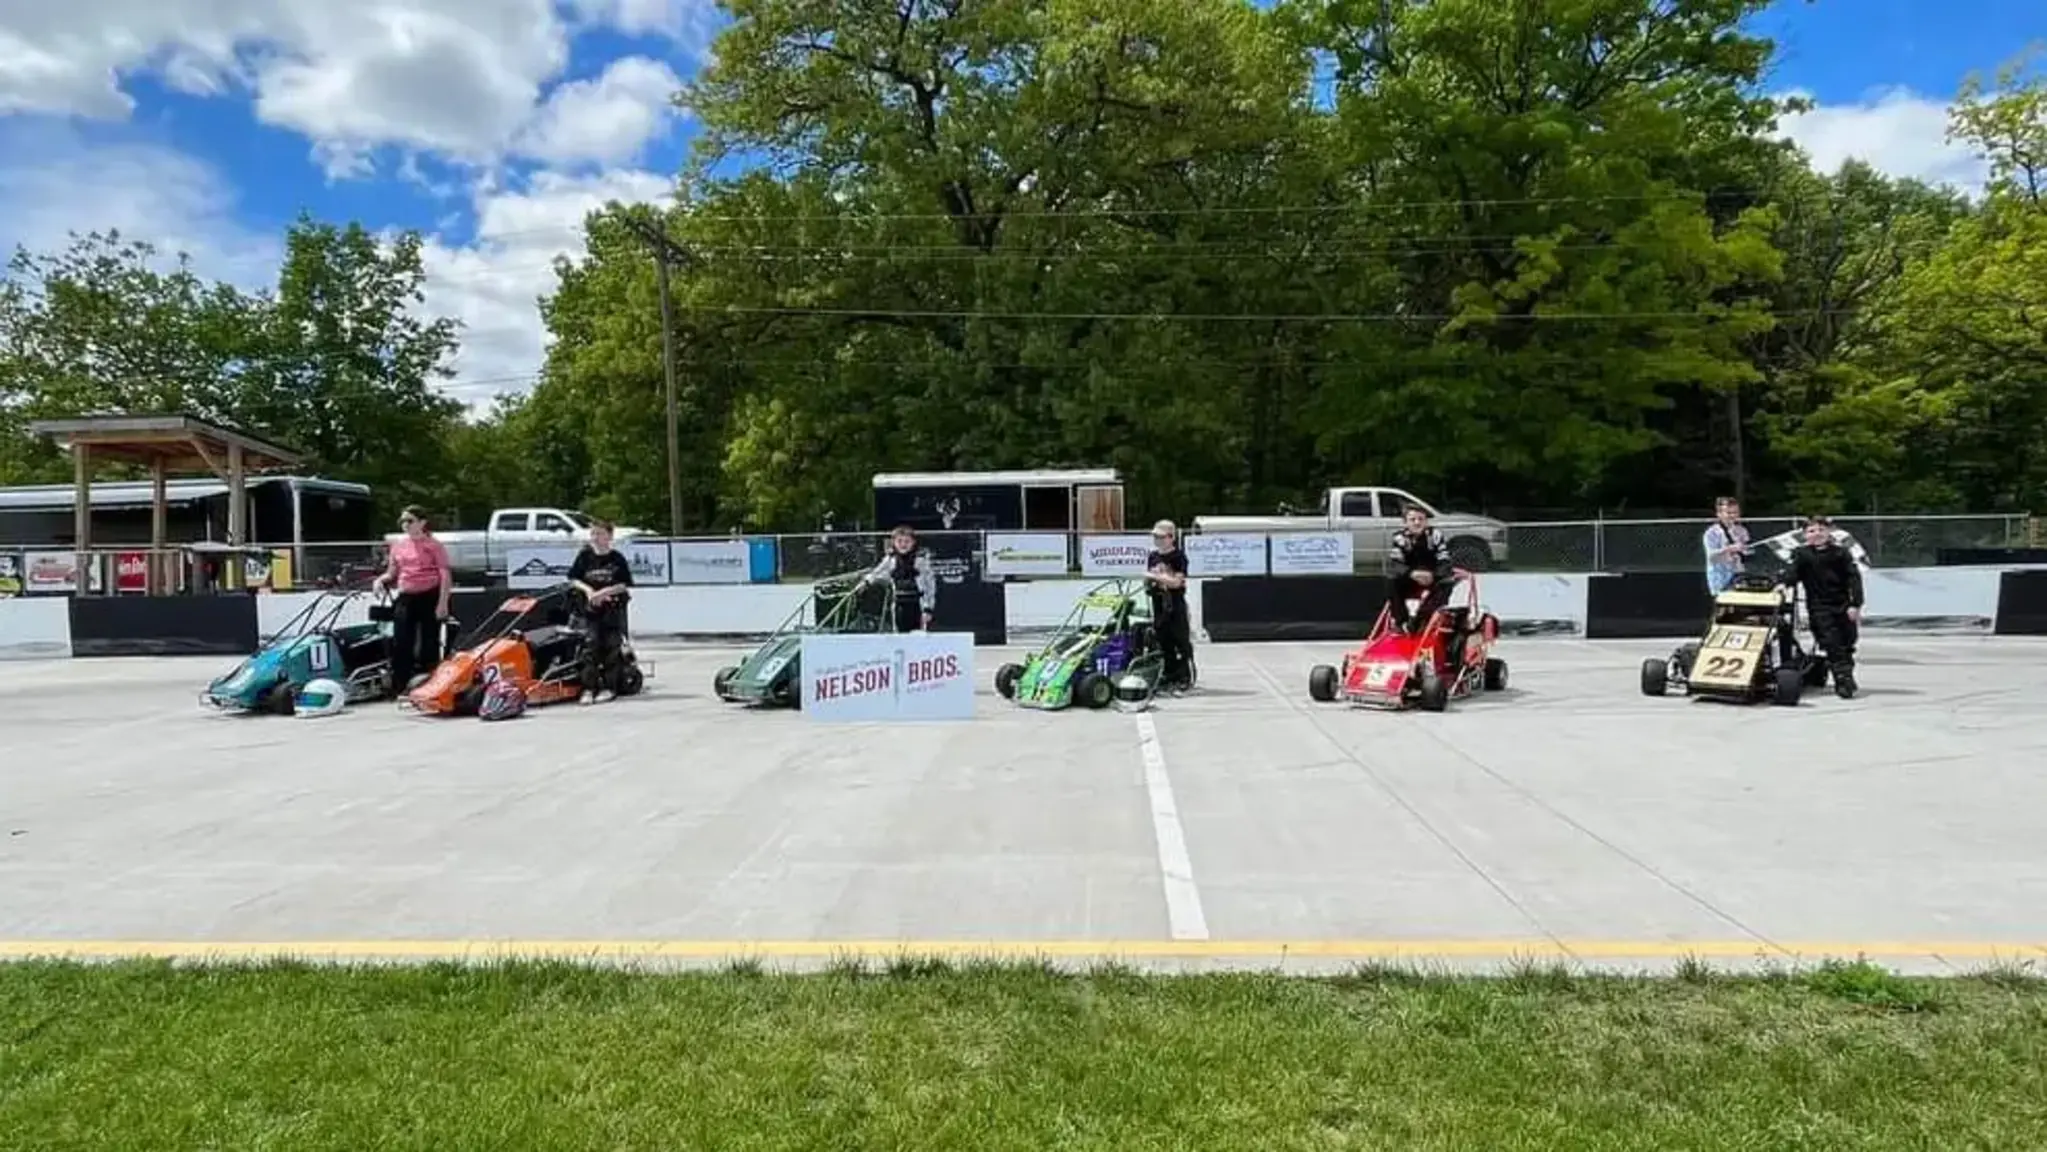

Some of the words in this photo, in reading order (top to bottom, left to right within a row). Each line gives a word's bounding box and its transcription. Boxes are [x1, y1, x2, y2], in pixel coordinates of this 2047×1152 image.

[815, 666, 890, 701] NELSON
[908, 655, 962, 685] BROS.
[1703, 656, 1745, 678] 22
